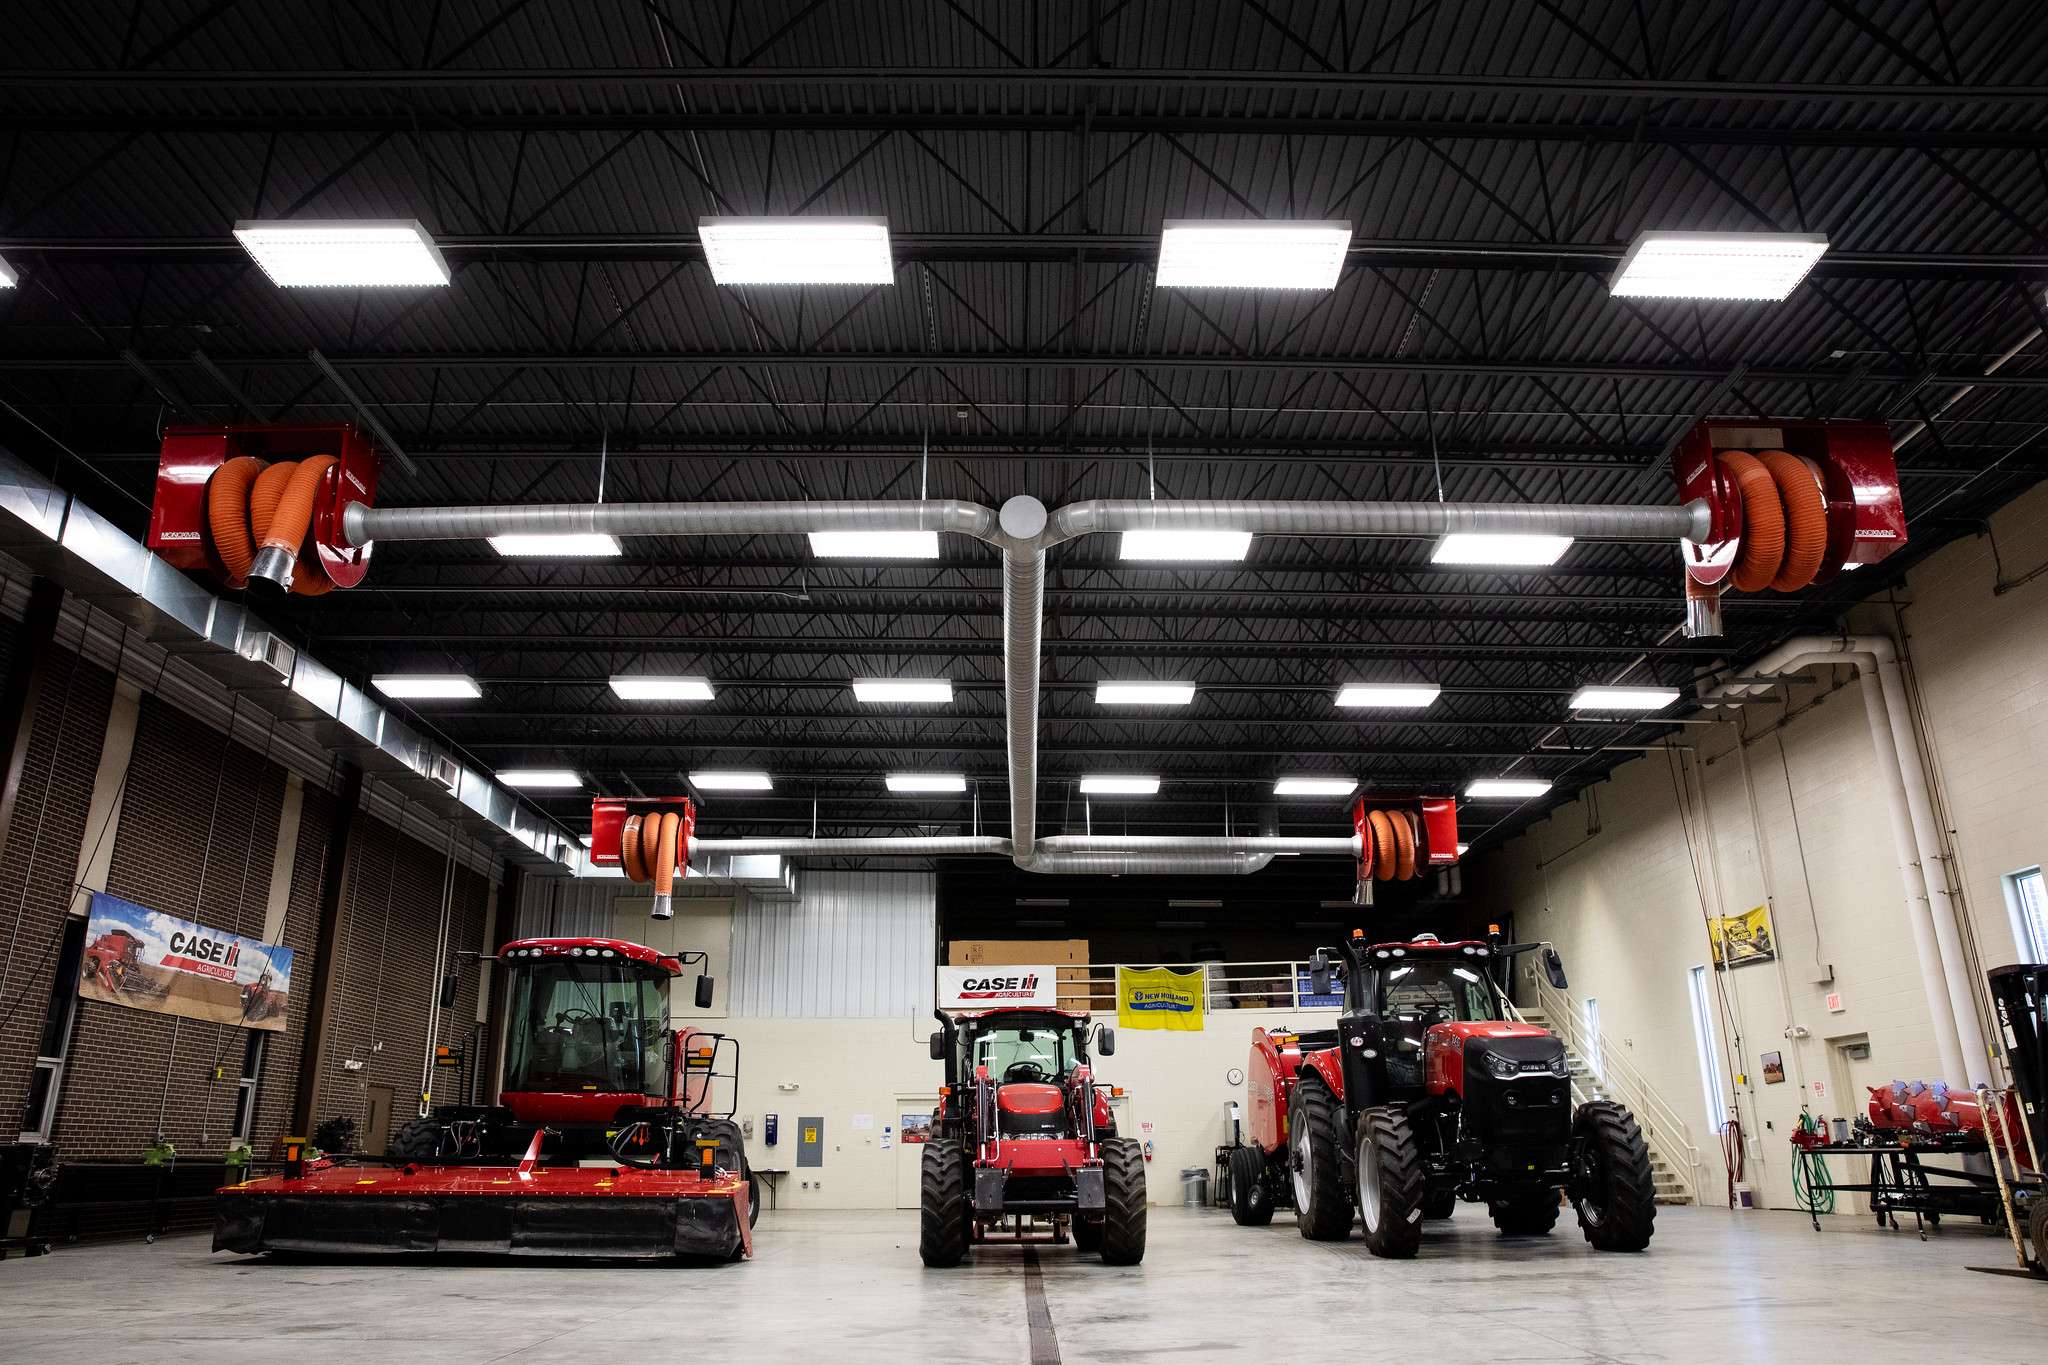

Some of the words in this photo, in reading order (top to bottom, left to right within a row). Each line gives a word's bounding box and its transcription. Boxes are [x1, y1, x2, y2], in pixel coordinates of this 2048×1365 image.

[170, 932, 224, 963] CASE
[196, 963, 233, 979] AGRICULTURE
[963, 977, 1018, 990] CASE
[1144, 992, 1160, 1000] NEW
[1161, 992, 1189, 1002] HOLLAND
[1828, 995, 1840, 1009] EXIT
[1998, 998, 2009, 1026] Yale
